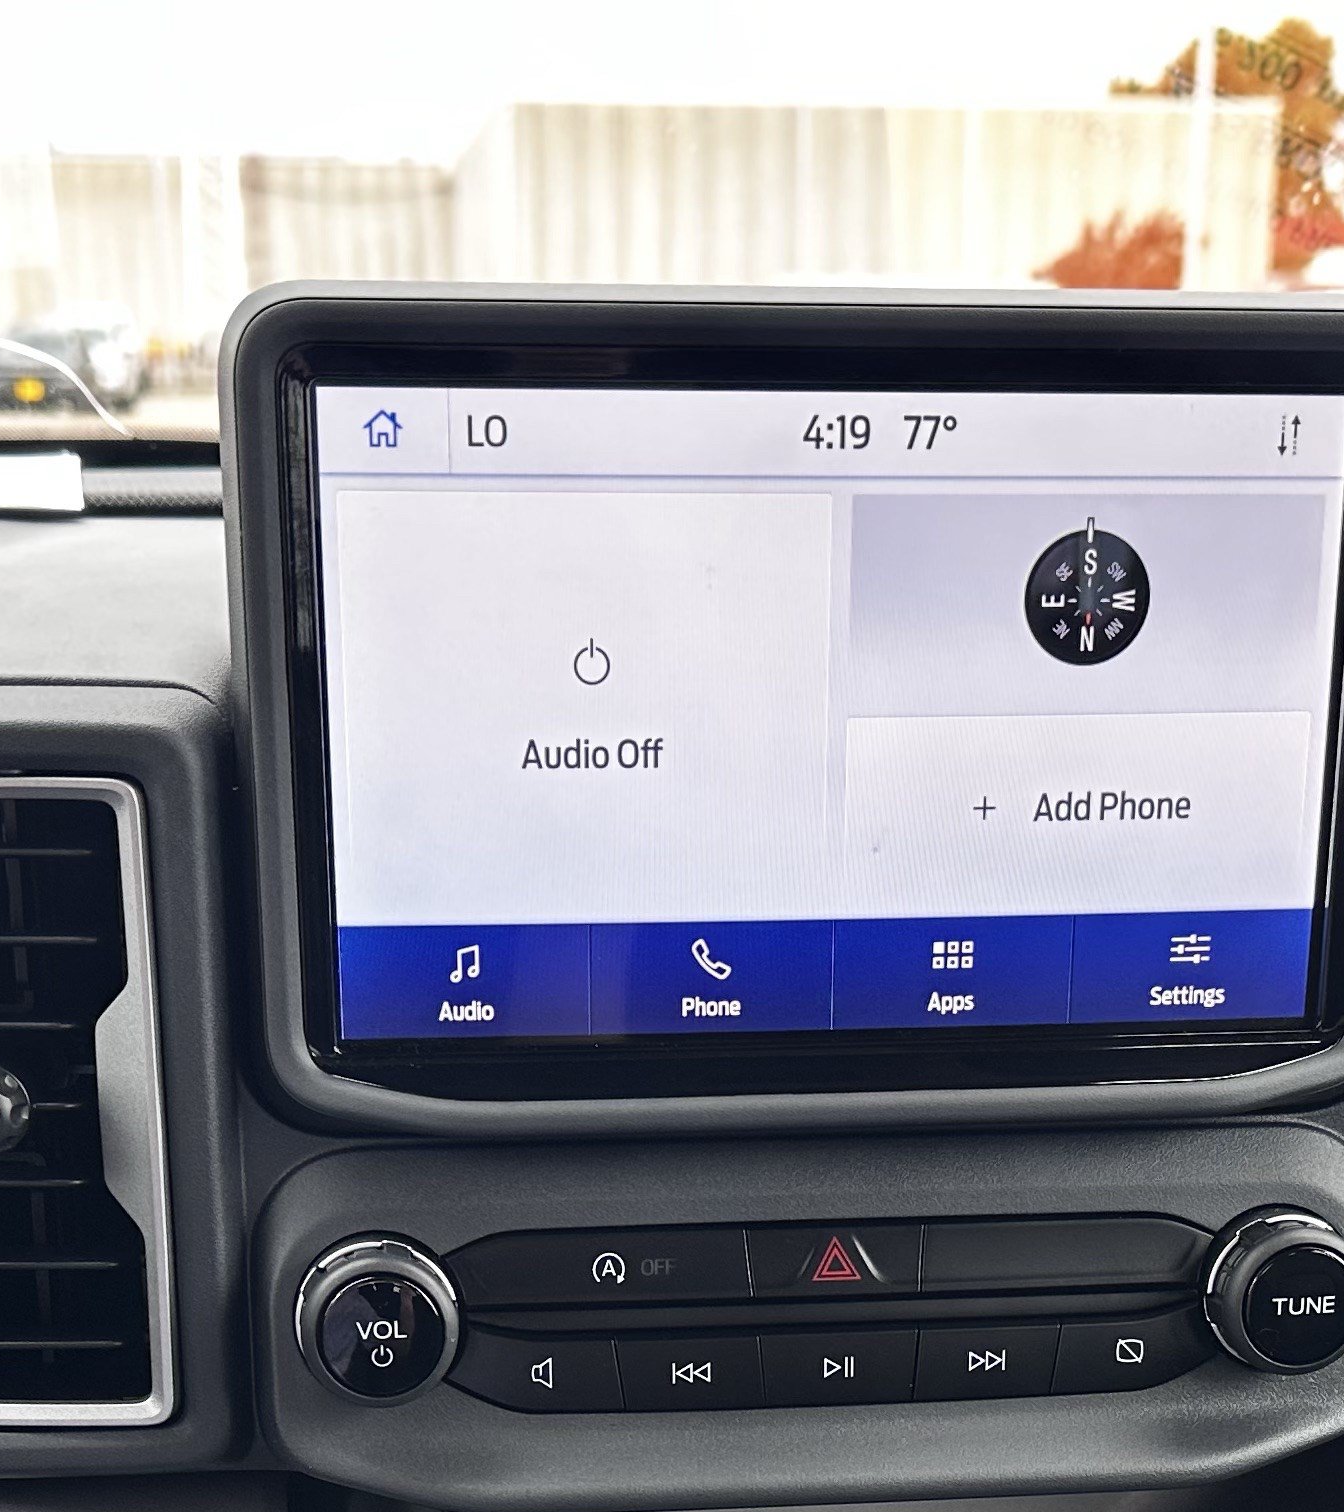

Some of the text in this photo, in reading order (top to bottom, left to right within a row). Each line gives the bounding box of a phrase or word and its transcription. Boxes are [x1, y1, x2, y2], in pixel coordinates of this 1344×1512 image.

[466, 414, 508, 448] LO
[802, 414, 958, 450] 4:19 77°
[1083, 548, 1098, 575] S
[1041, 593, 1065, 608] E
[1111, 588, 1137, 612] W
[1079, 625, 1095, 652] N
[521, 736, 664, 770] Audio Off
[1033, 789, 1192, 823] Add Phone
[681, 996, 742, 1018] Phone
[927, 992, 975, 1015] Apps
[1149, 985, 1226, 1009] Settings
[438, 1000, 495, 1023] Audio
[1271, 1295, 1336, 1318] TUNE
[356, 1320, 408, 1341] VOL
